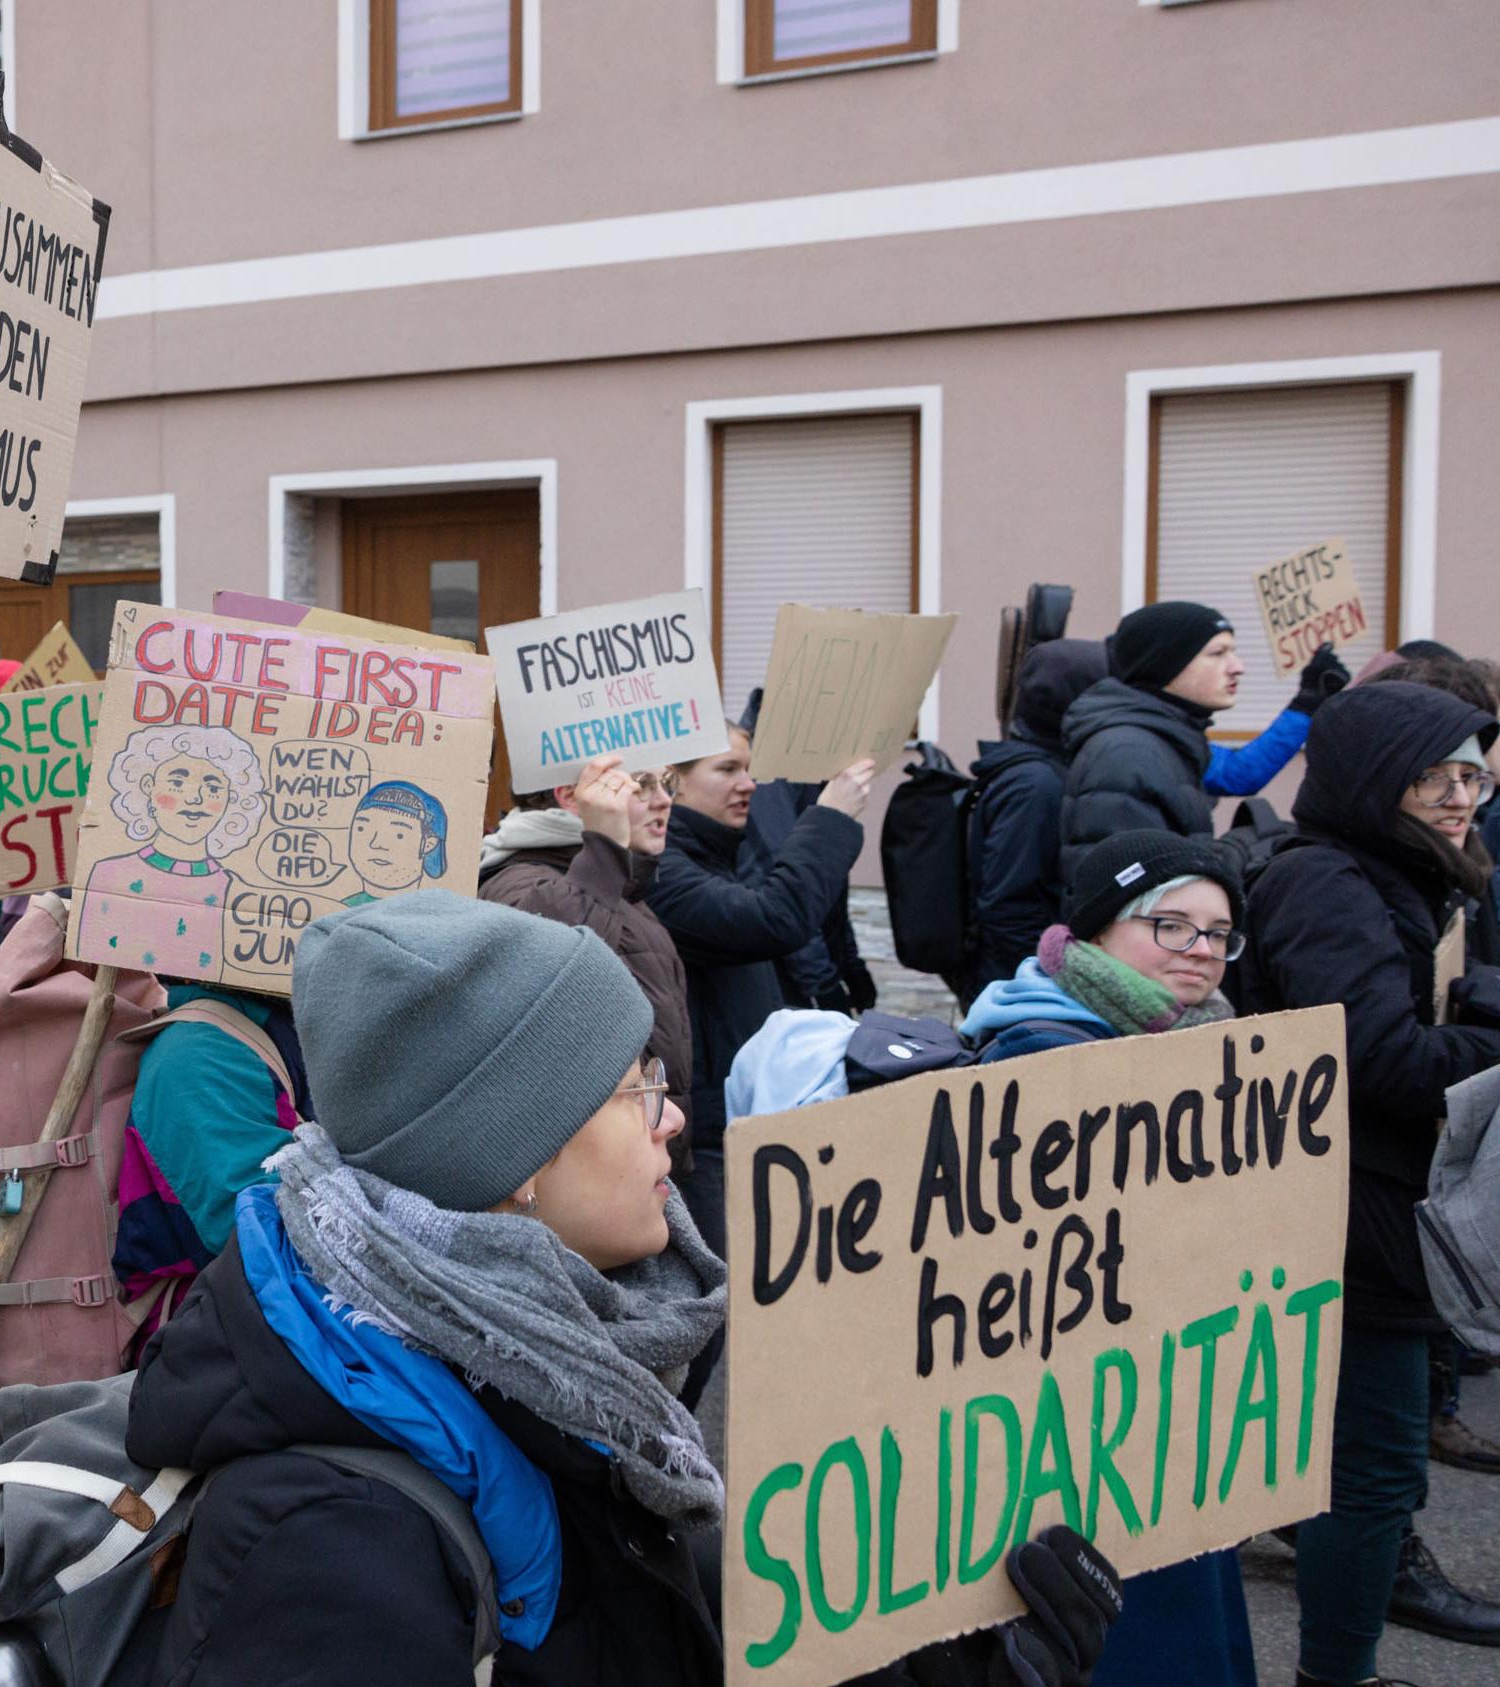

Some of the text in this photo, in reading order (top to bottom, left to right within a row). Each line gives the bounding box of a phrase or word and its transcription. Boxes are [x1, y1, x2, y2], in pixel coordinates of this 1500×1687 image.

[135, 621, 462, 711] CUTE FIRST
[517, 613, 694, 694] FASCHISMUS
[1277, 597, 1366, 669] STOPPEN
[133, 681, 443, 746] DATE IDEA:
[577, 672, 662, 709] IST KEINE
[275, 747, 355, 771] WEN
[541, 698, 701, 767] ALTERNATIVE!
[275, 773, 370, 798] WÄHLST
[282, 800, 328, 822] DU?
[272, 832, 320, 854] DIE
[232, 892, 312, 930] CIAO
[753, 1033, 1338, 1306] Die Alternative
[916, 1207, 1132, 1378] heißt
[744, 1265, 1342, 1669] SOLIDARITÄT
